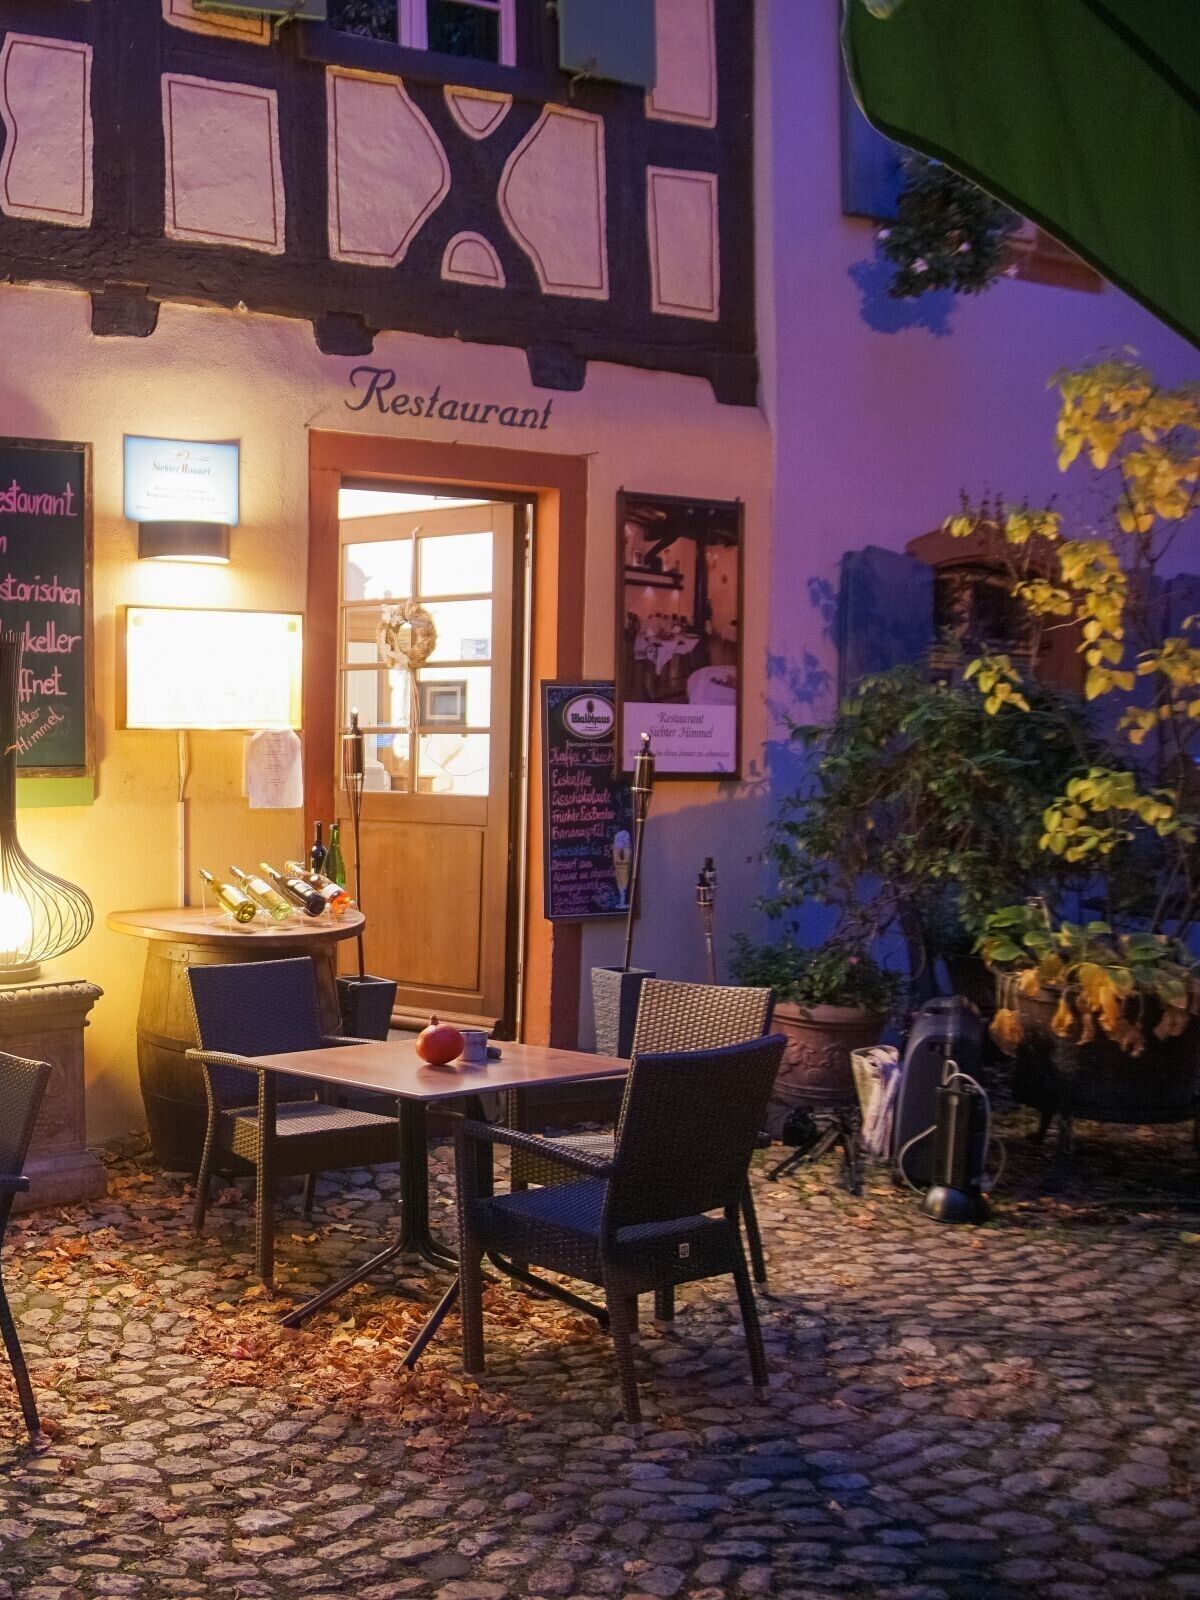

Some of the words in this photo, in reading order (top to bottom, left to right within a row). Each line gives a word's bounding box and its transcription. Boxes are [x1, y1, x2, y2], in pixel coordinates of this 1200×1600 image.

[344, 365, 554, 430] Restaurant
[19, 665, 68, 704] ffnet
[6, 704, 65, 755] Himmel
[571, 712, 611, 725] Waldhaus
[658, 711, 705, 724] Restaurant
